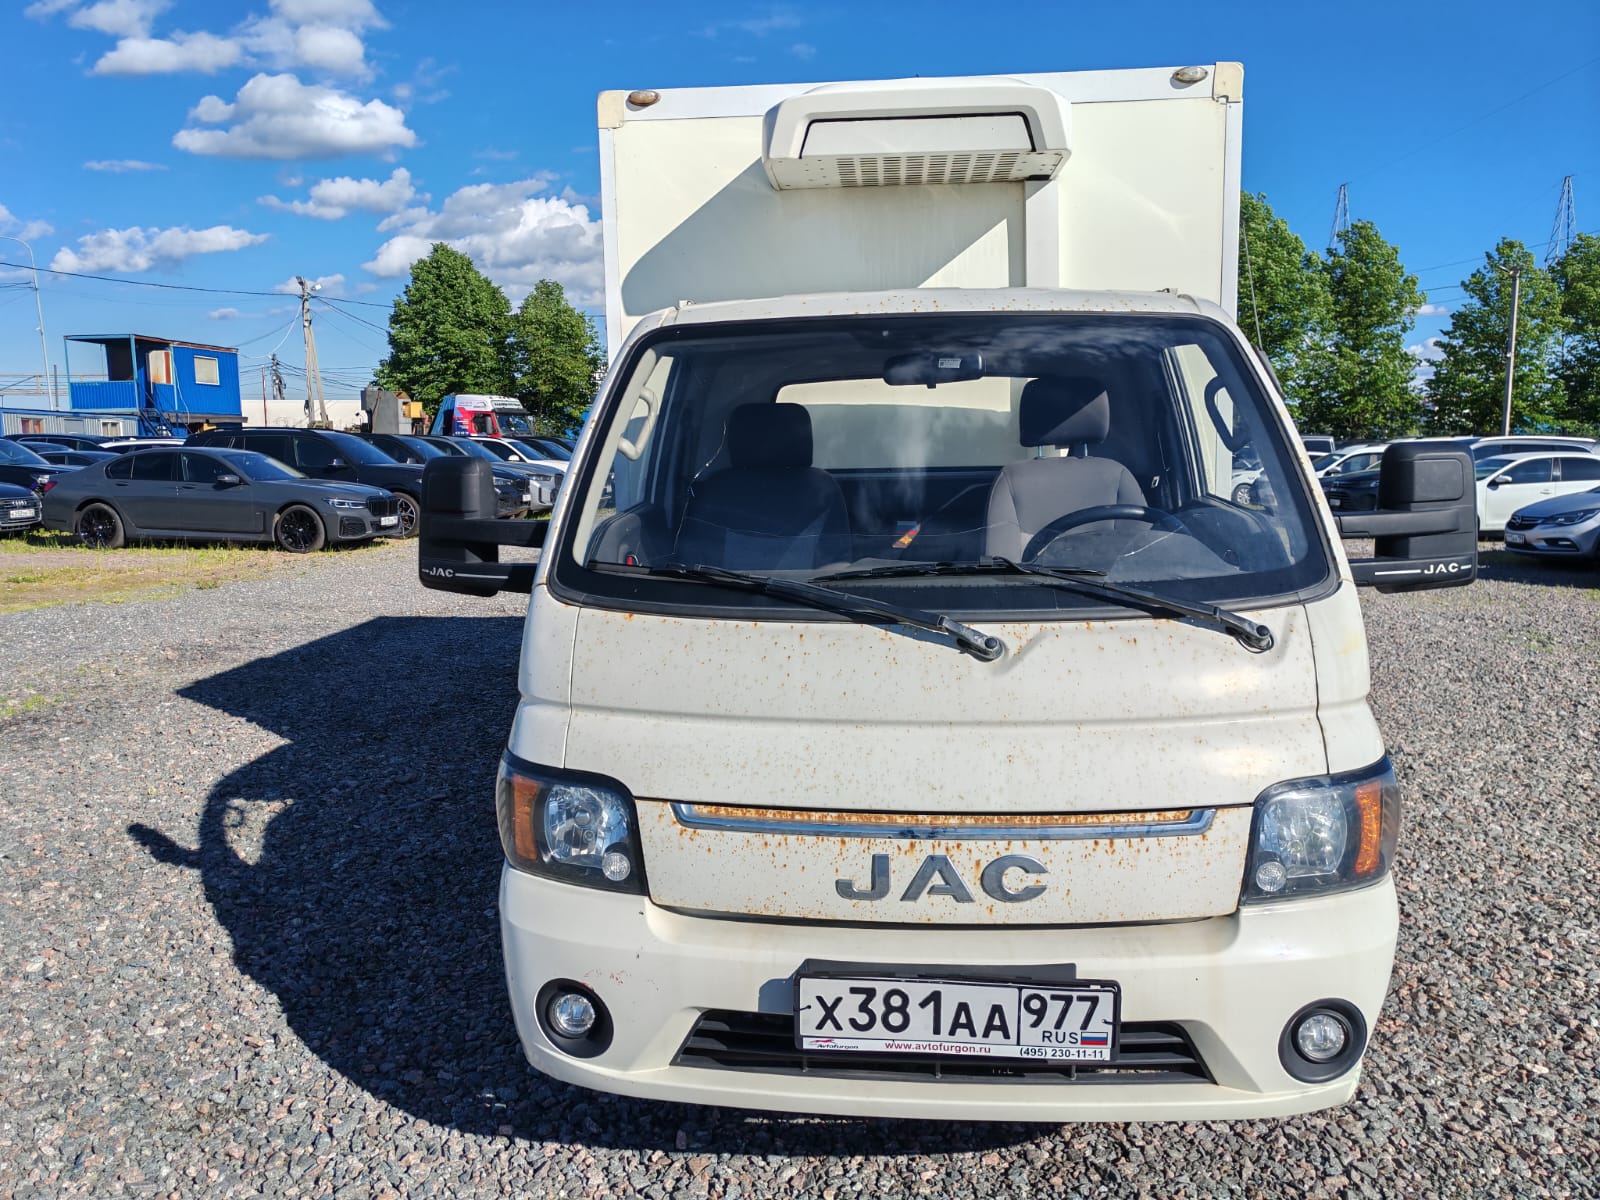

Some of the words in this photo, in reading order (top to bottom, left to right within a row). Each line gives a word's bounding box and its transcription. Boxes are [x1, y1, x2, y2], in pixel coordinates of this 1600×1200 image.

[429, 566, 454, 578] JAC
[1424, 562, 1459, 574] JAC
[835, 853, 1049, 903] JAC
[1023, 993, 1100, 1030] 977
[1042, 1030, 1079, 1044] RUS
[885, 1042, 991, 1054] www.avtofurgon.ru
[1020, 1047, 1047, 1057] (495)
[1051, 1048, 1103, 1059] 230-11-11
